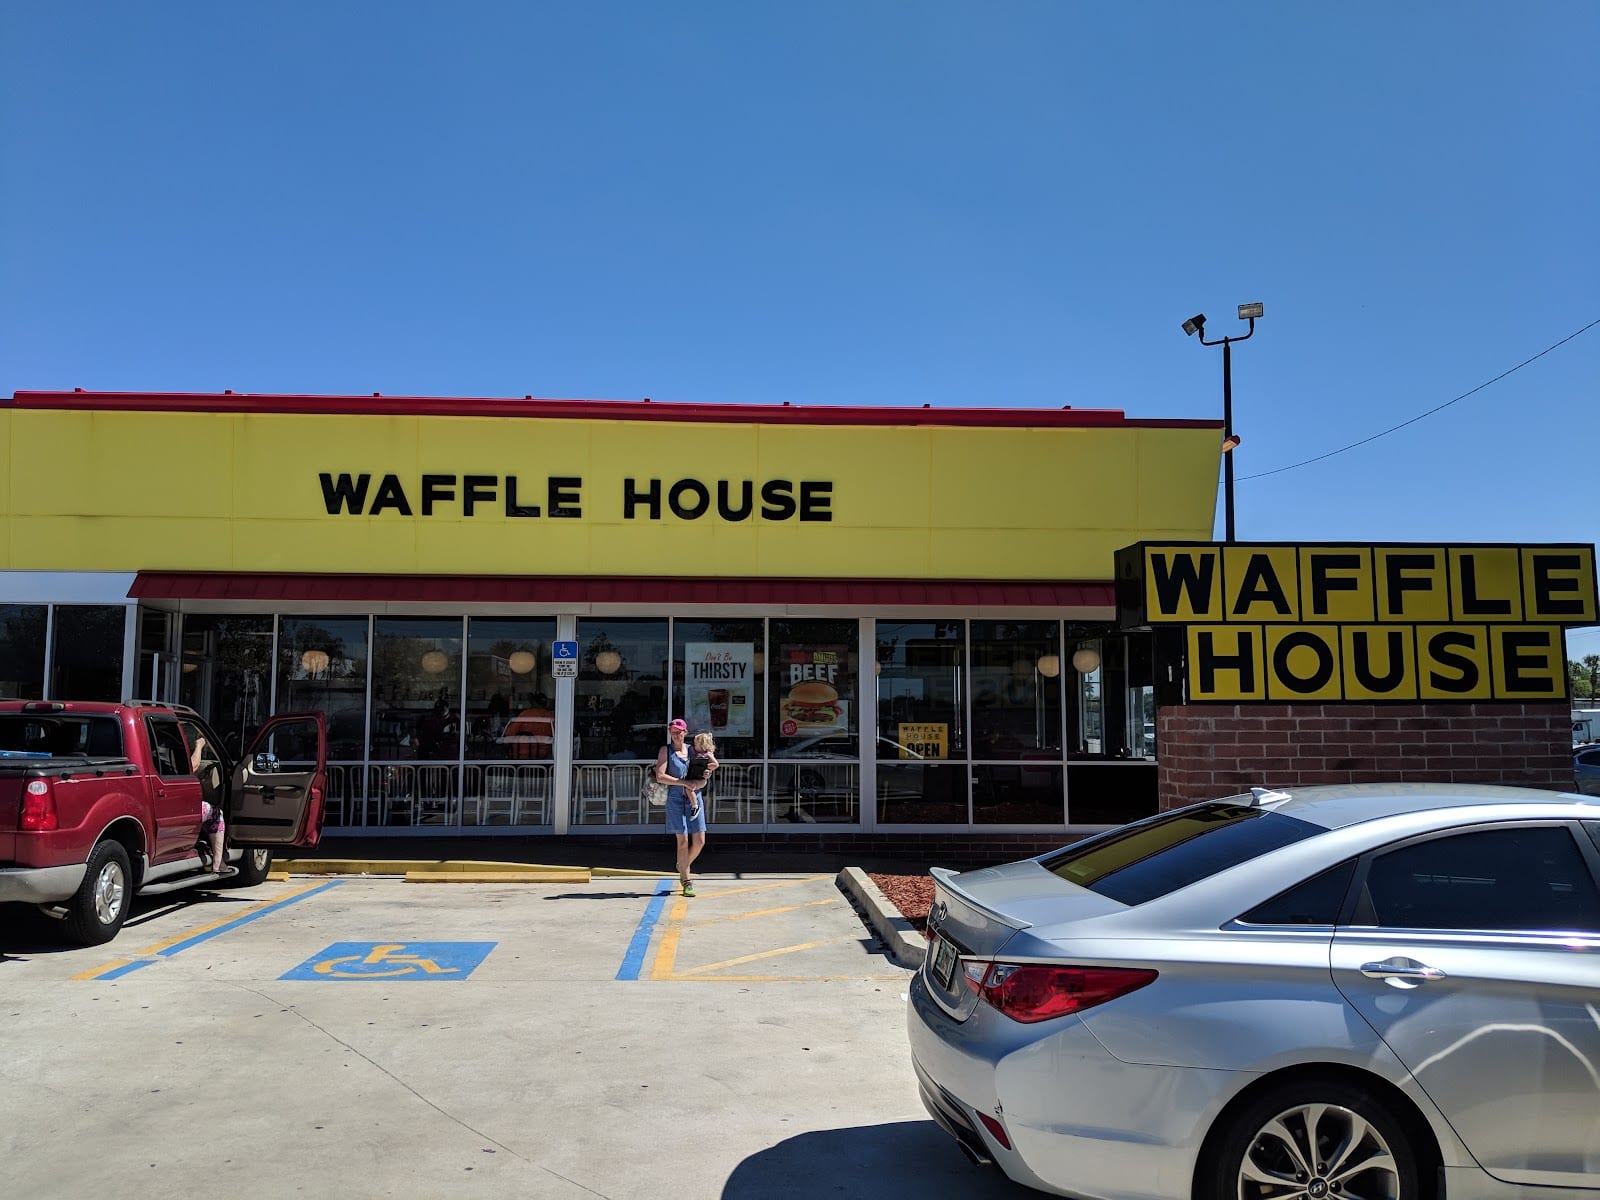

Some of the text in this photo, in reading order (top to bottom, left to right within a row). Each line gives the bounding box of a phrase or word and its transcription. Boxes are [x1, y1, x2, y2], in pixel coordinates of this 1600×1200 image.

[319, 473, 832, 521] WAFFLE HOUSE
[1151, 553, 1585, 615] WAFFLE
[691, 662, 747, 678] THIRSTY
[790, 664, 838, 686] BEEF
[1197, 631, 1554, 694] HOUSE
[907, 742, 940, 757] OPEN
